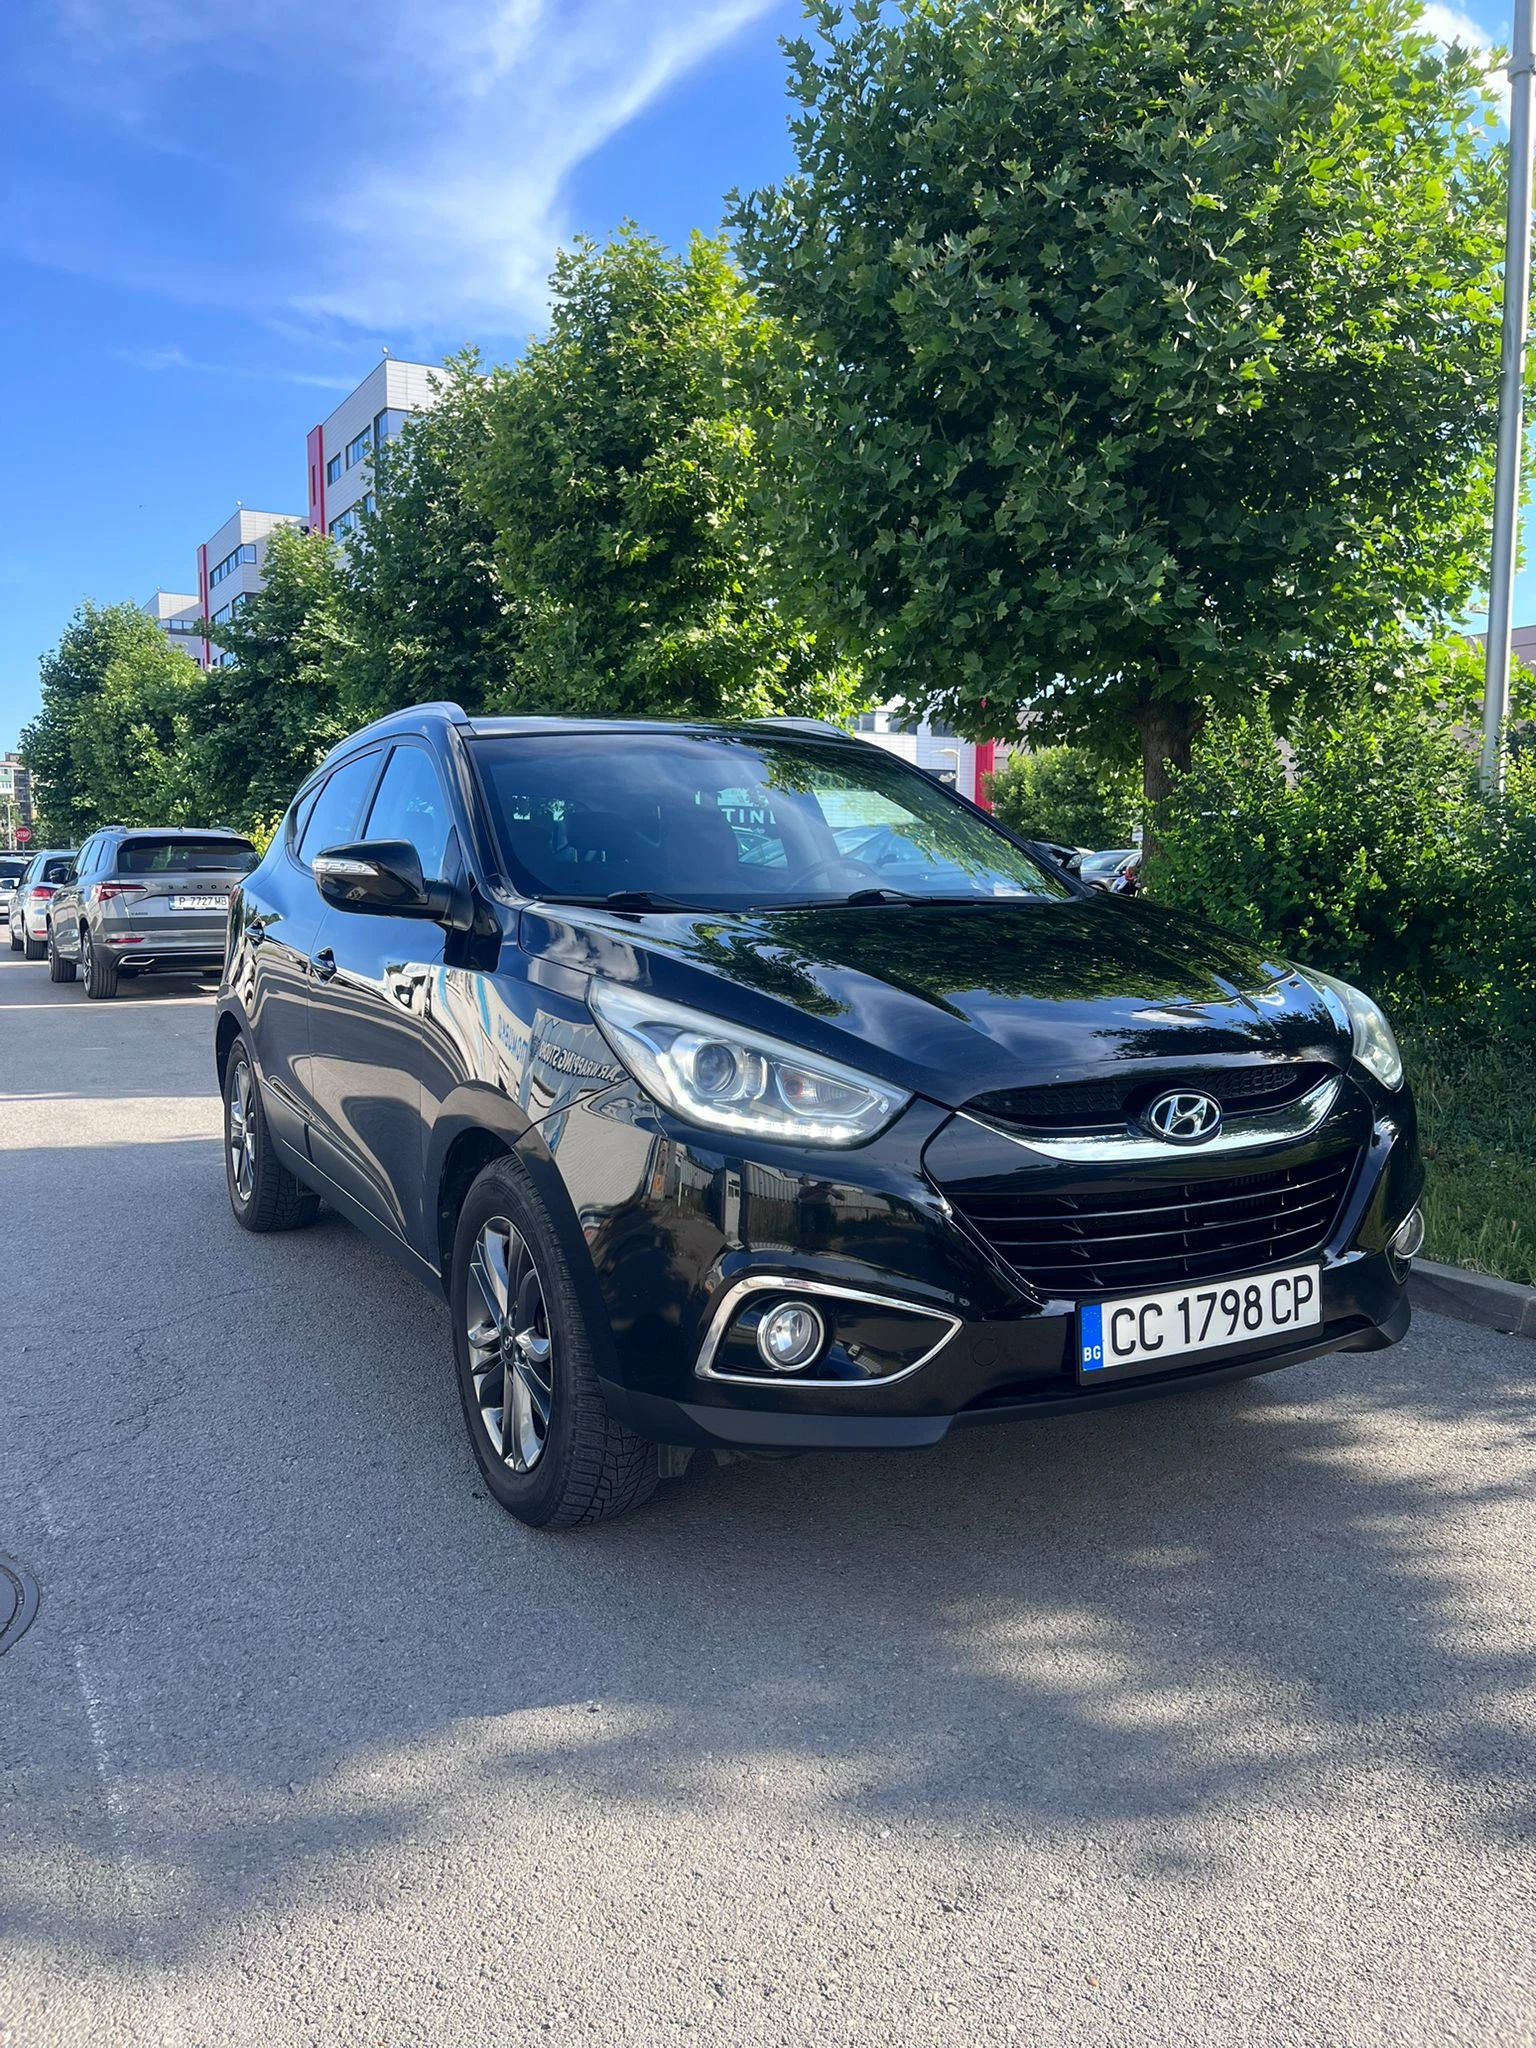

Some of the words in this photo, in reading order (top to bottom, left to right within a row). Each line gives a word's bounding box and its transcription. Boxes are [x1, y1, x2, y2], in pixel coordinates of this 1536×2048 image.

[180, 897, 186, 905] P
[190, 897, 212, 905] 7727
[1110, 1303, 1164, 1356] CC
[1177, 1284, 1263, 1345] 1798
[1271, 1274, 1314, 1325] CP
[1084, 1345, 1101, 1361] BG
